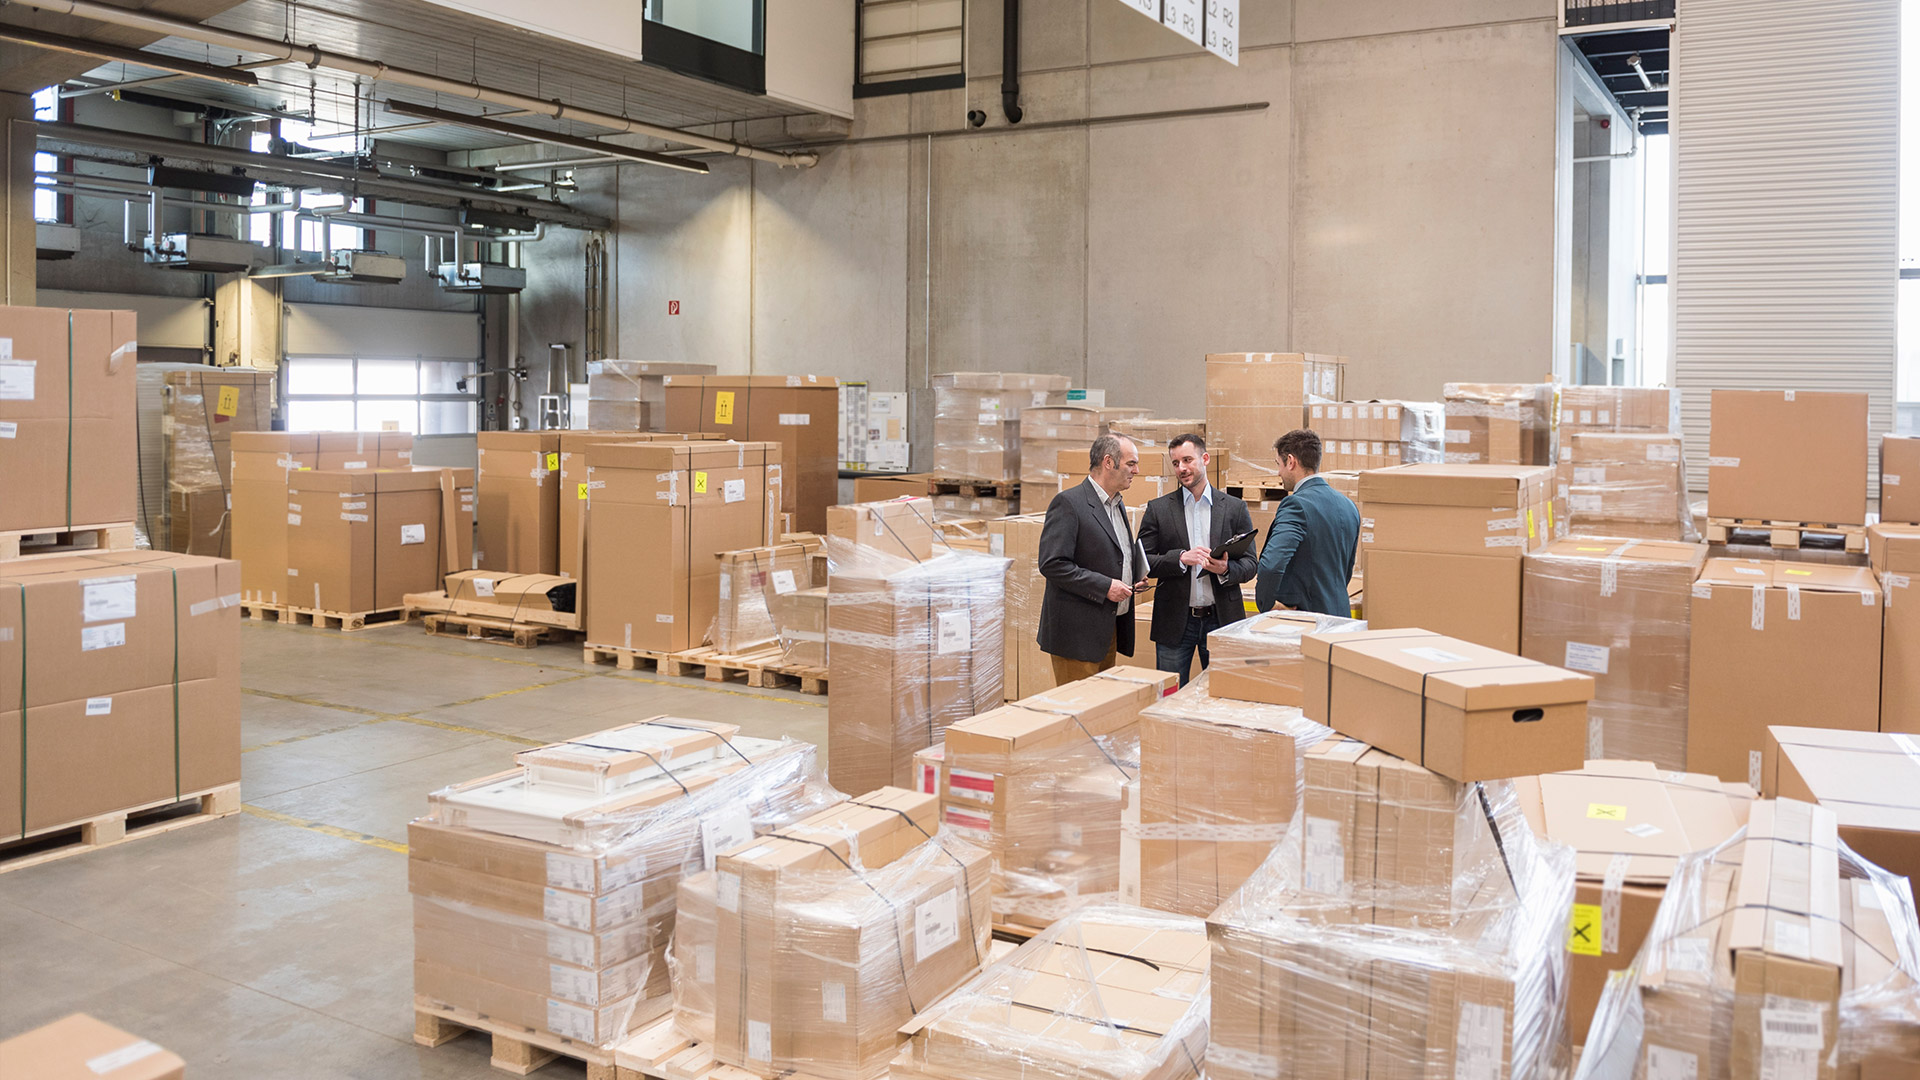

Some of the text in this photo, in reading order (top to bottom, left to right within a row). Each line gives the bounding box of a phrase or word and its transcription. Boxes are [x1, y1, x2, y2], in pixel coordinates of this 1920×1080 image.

[1166, 3, 1194, 35] L3 R3
[1208, 0, 1233, 28] L2 R2
[1207, 27, 1233, 57] L3 R3
